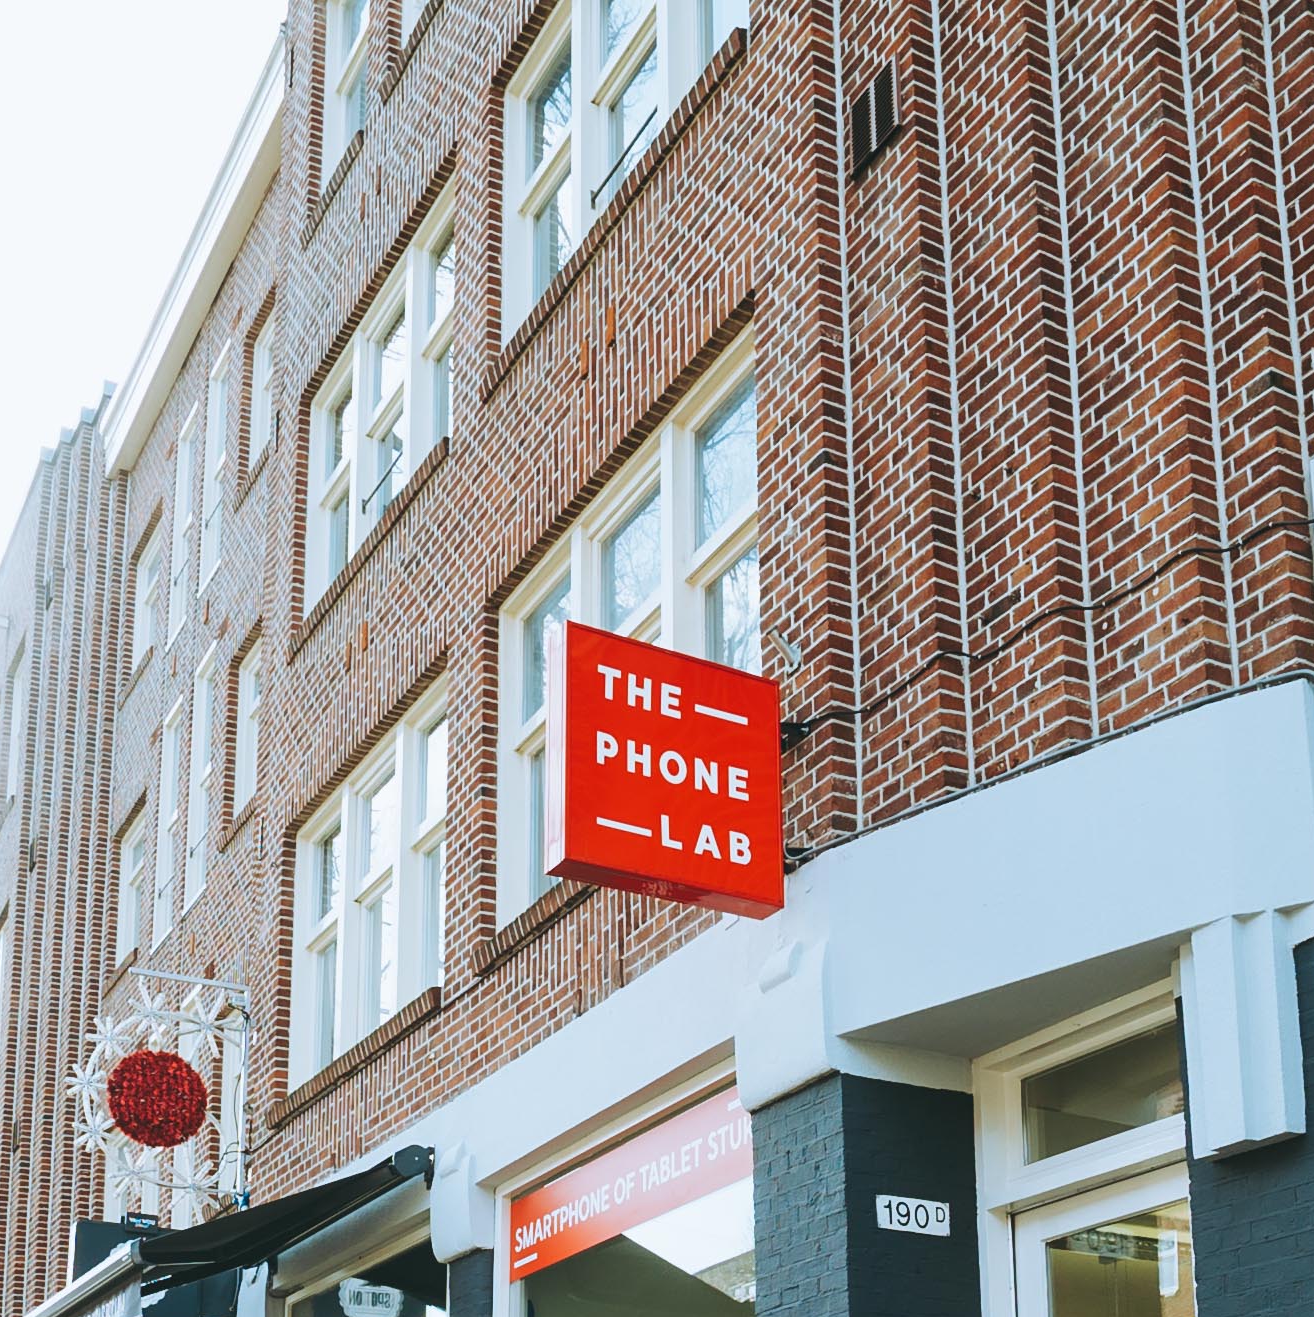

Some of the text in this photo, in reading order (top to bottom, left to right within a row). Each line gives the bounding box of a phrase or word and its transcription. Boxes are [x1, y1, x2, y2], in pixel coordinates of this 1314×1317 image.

[597, 663, 682, 719] THE
[596, 730, 749, 802] PHONE
[660, 814, 752, 865] LAB
[514, 1184, 610, 1253] SMARTPHONE
[613, 1171, 635, 1205] OF
[639, 1137, 703, 1192] TABLET
